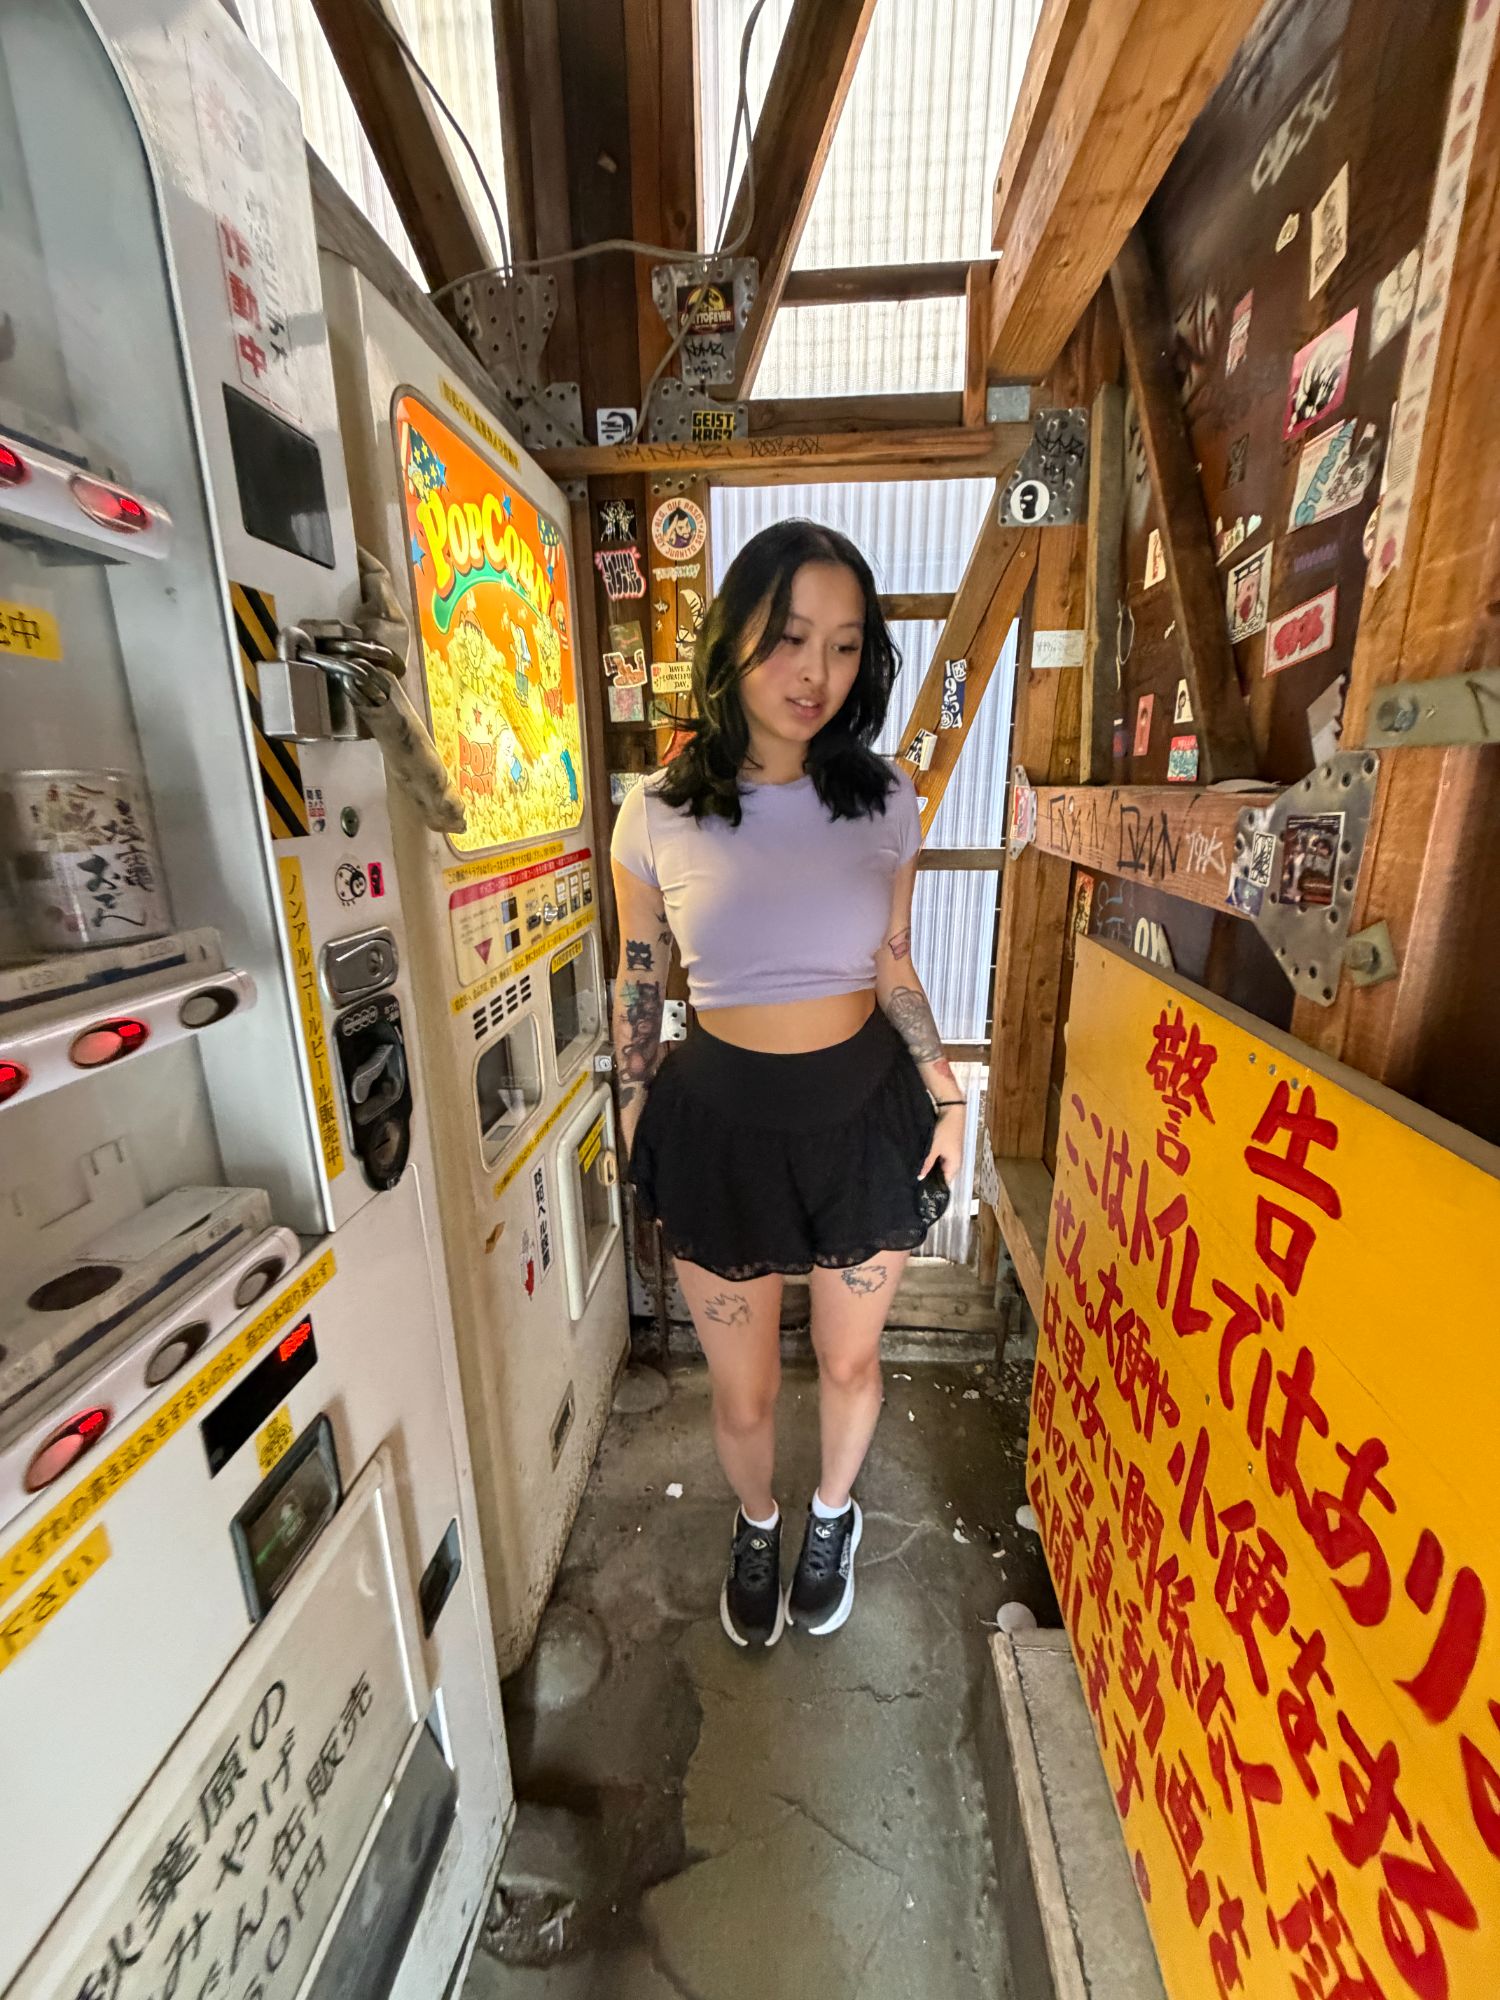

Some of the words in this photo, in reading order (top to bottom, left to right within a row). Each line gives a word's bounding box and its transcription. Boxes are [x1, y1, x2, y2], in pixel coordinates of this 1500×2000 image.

[681, 311, 731, 326] GTTOFEVER
[693, 412, 733, 428] GEIST
[0, 611, 40, 649] 中
[663, 673, 691, 681] GRATEFU
[288, 874, 341, 1166] ノンアルコールビール販売中
[1146, 1005, 1342, 1296] 警告
[148, 1727, 297, 2000] みやげ
